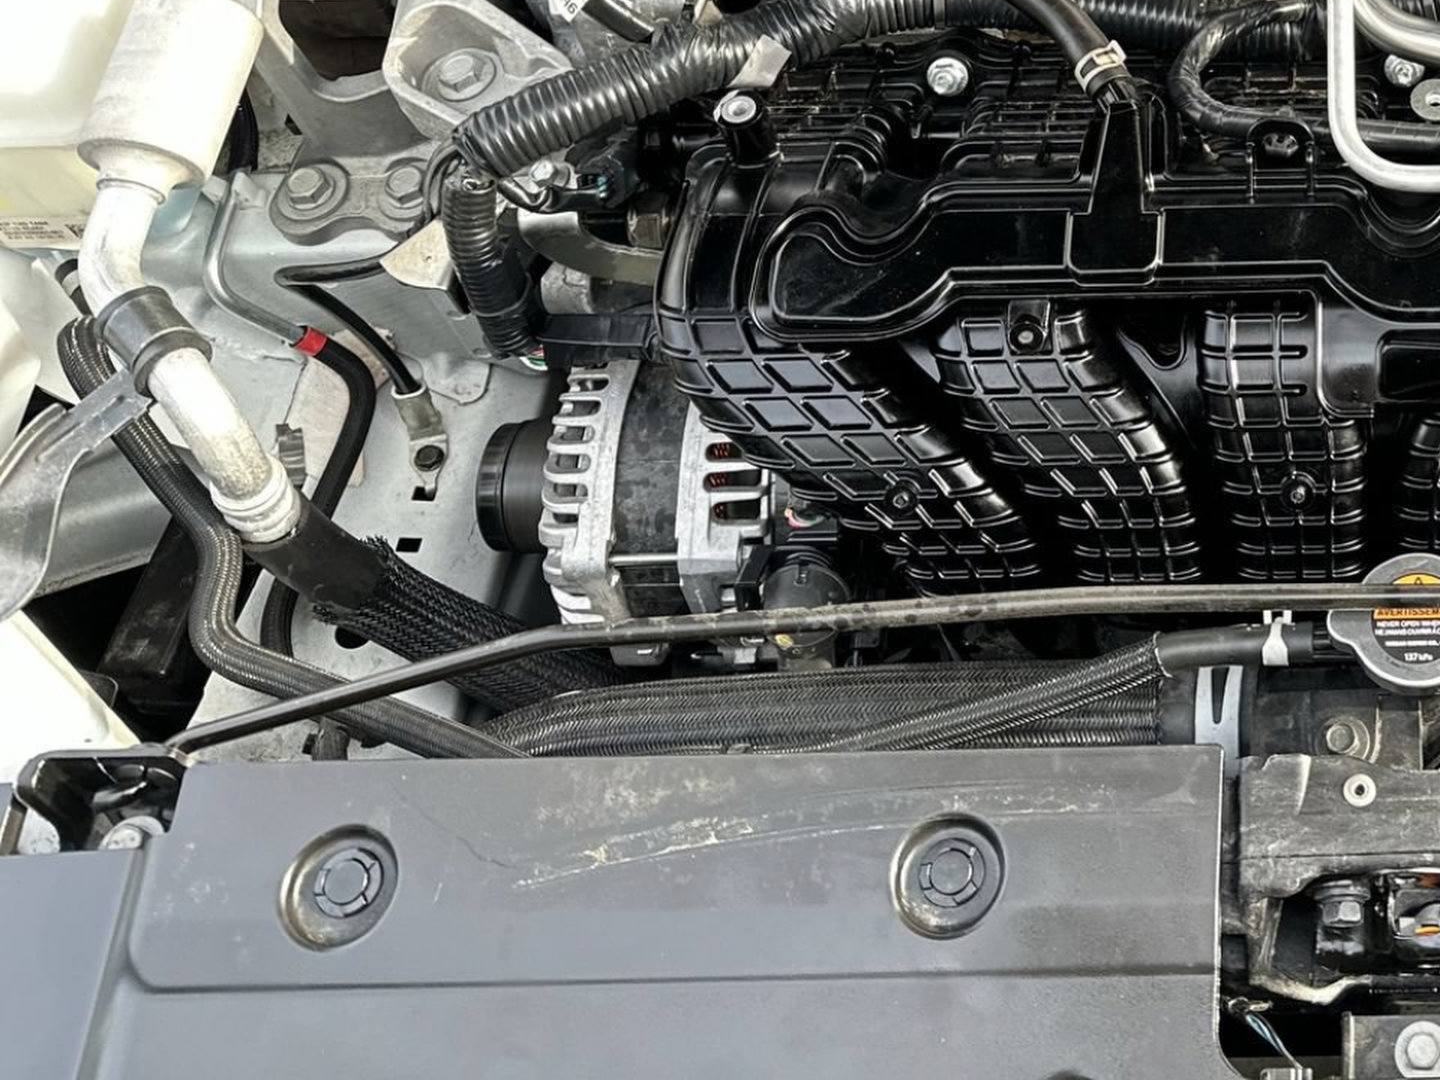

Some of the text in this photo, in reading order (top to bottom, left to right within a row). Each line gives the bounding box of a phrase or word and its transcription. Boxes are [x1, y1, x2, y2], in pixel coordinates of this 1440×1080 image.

[1376, 620, 1400, 628] NEVER
[1401, 620, 1420, 628] OPEN
[1404, 652, 1418, 662] 137
